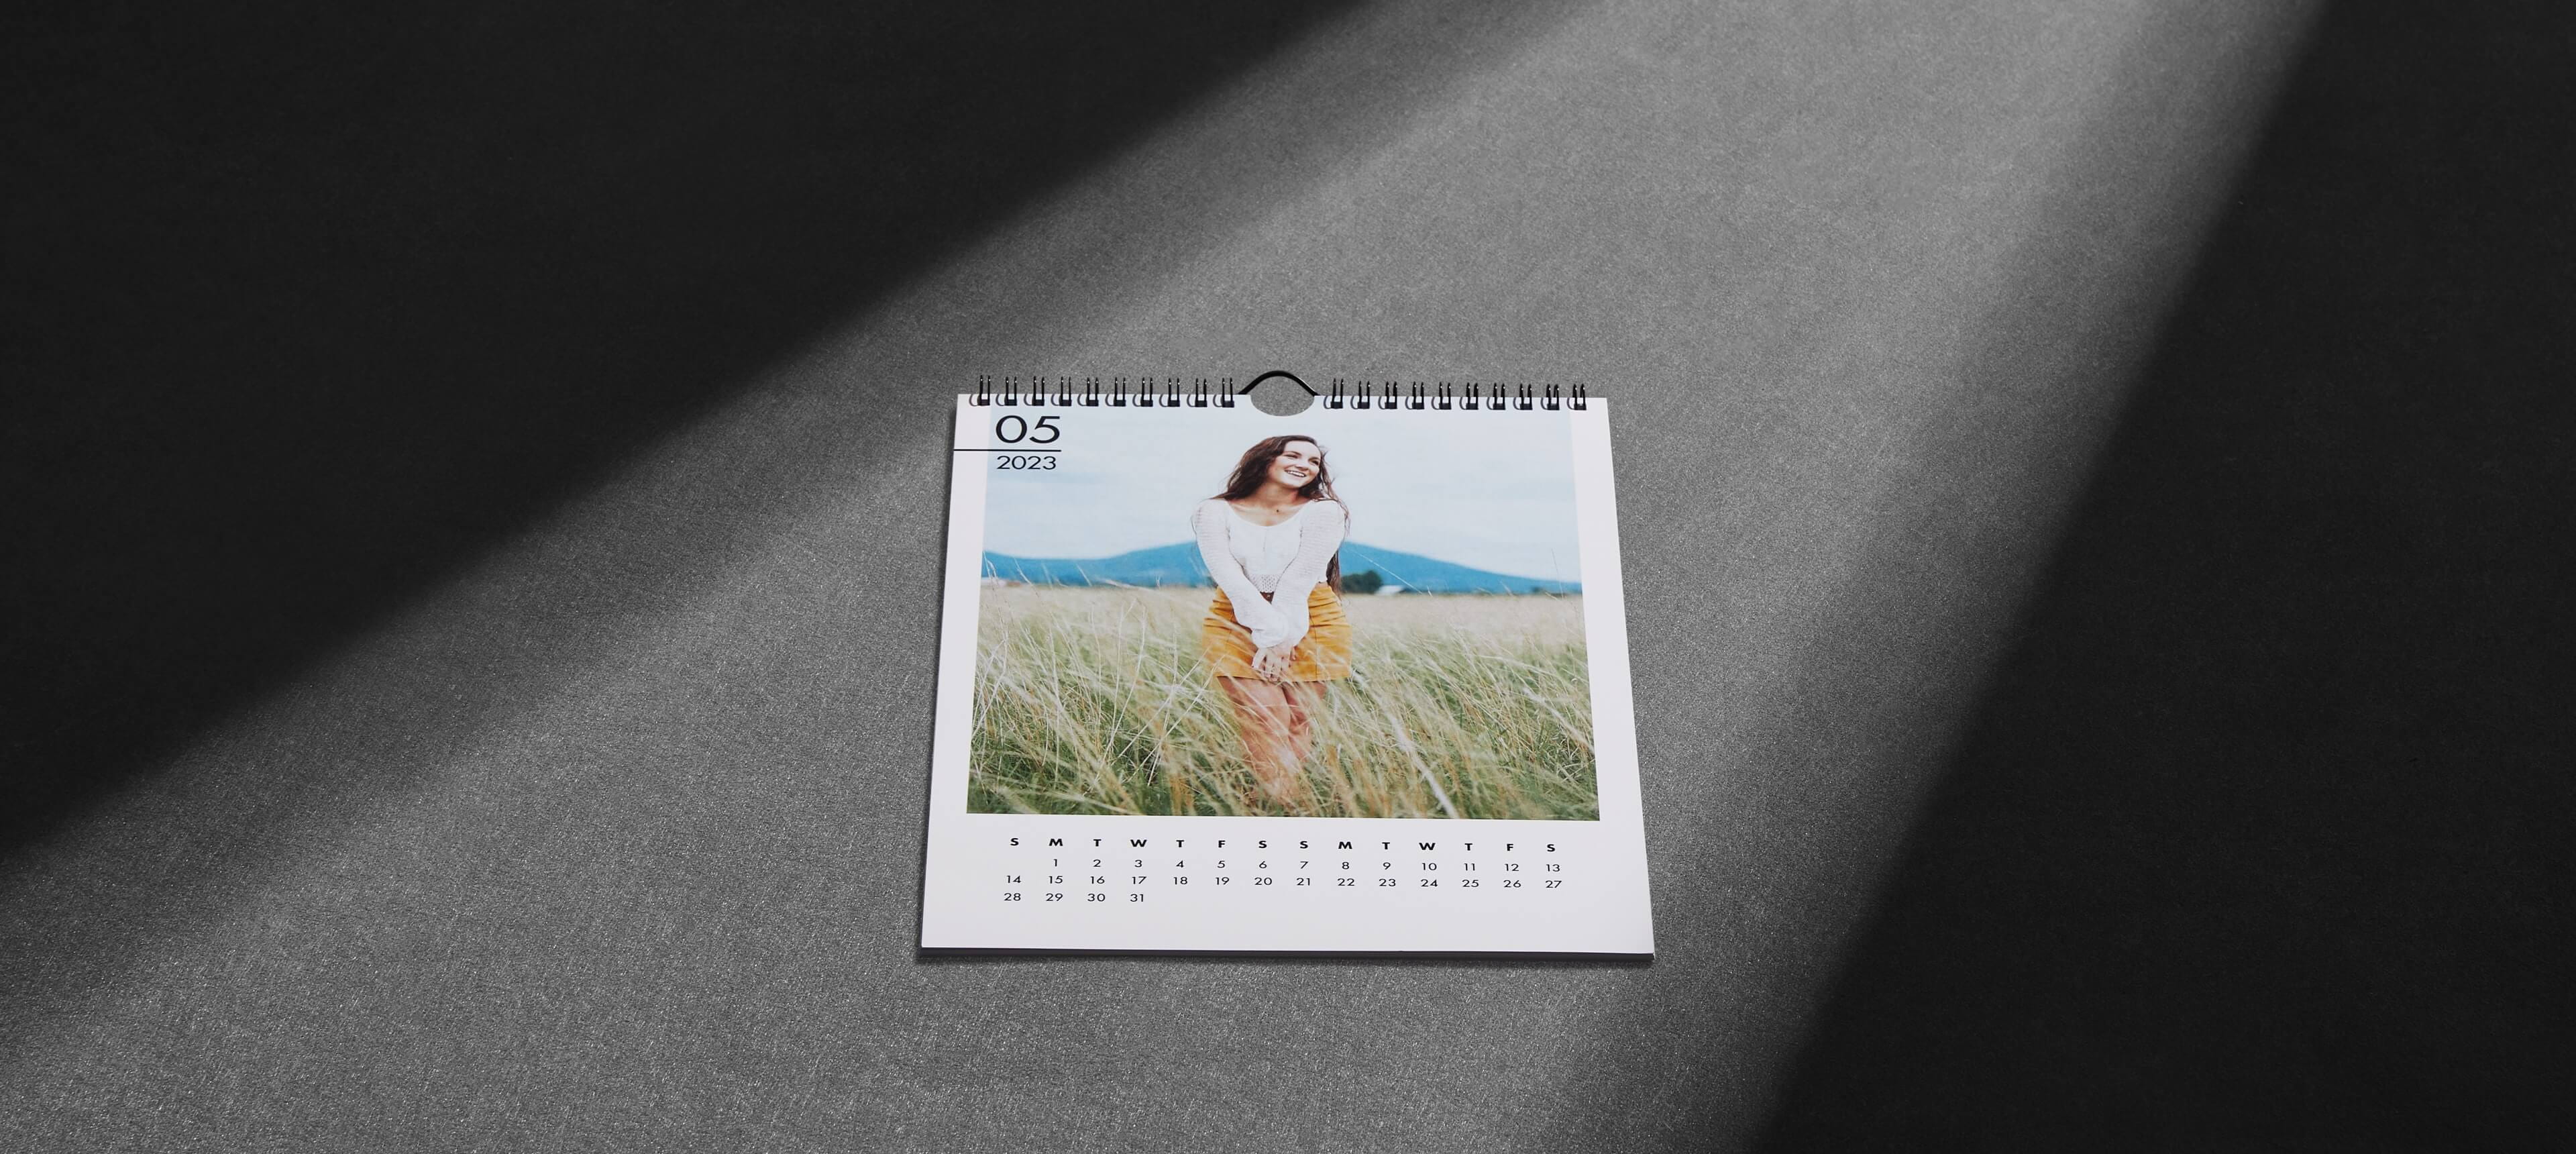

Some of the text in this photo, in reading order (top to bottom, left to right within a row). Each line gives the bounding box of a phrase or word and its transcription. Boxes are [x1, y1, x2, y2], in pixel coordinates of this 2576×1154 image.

[996, 415, 1061, 443] 05
[996, 455, 1057, 470] 2023
[1010, 837, 1556, 853] S M T W T F S S M T W T F S
[1053, 858, 1560, 872] 1 2 3 4 5 6 7 8 9 10 11 12 13
[1006, 875, 1562, 889] 14 15 16 17 18 19 20 21 22 23 24 25 26 27
[1004, 892, 1144, 902] 28 29 30 31
